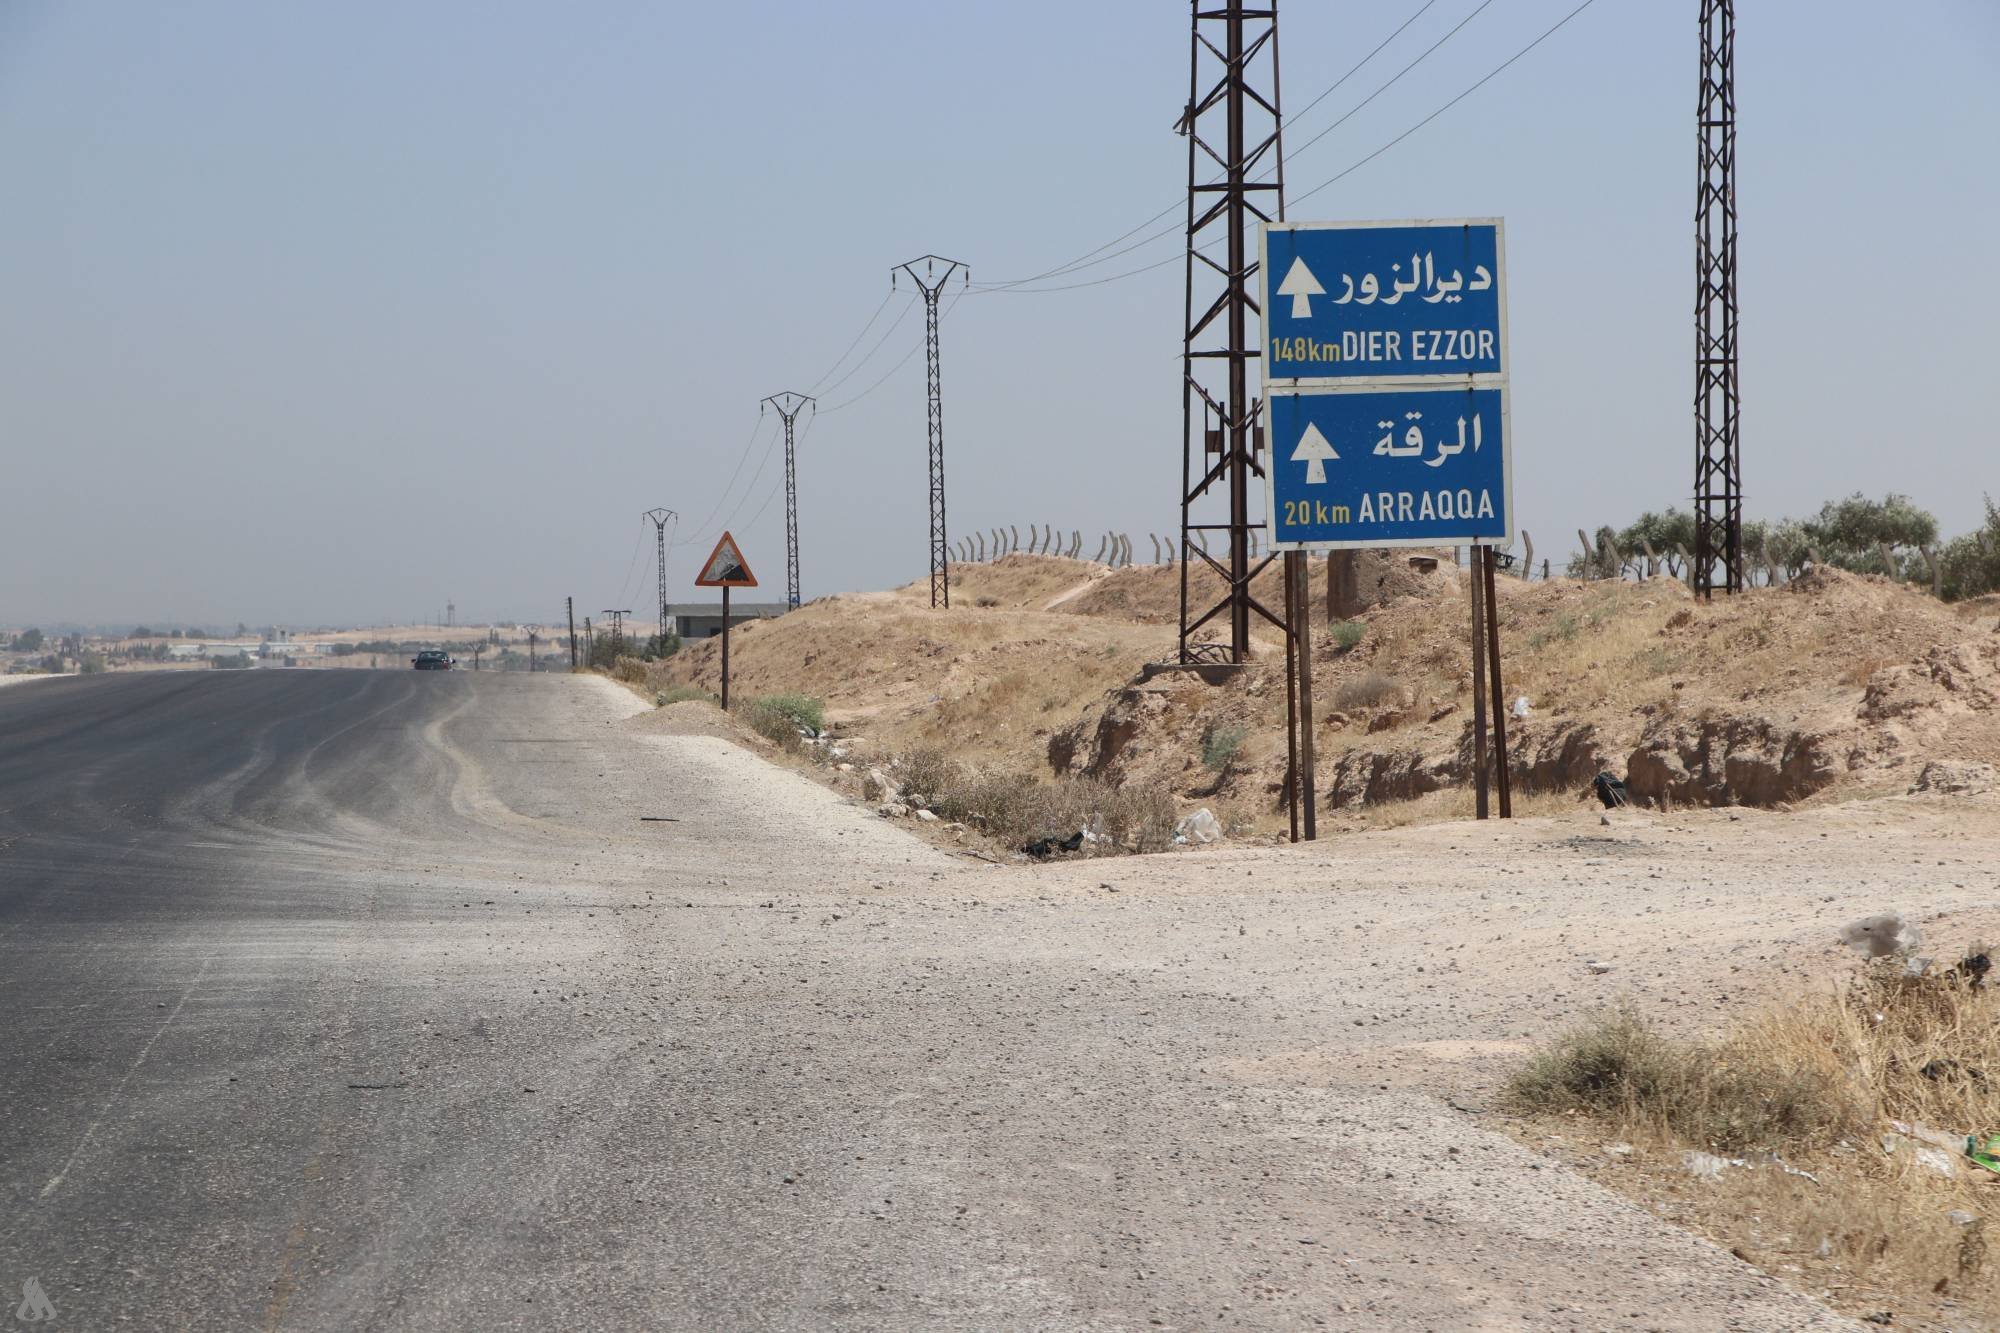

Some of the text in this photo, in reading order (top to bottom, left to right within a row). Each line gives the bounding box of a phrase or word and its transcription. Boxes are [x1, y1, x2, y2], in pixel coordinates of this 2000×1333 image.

[1272, 329, 1495, 362] 148km DIER EZZOR
[1372, 411, 1482, 468] الرقة
[1358, 488, 1495, 523] ARRAQQA
